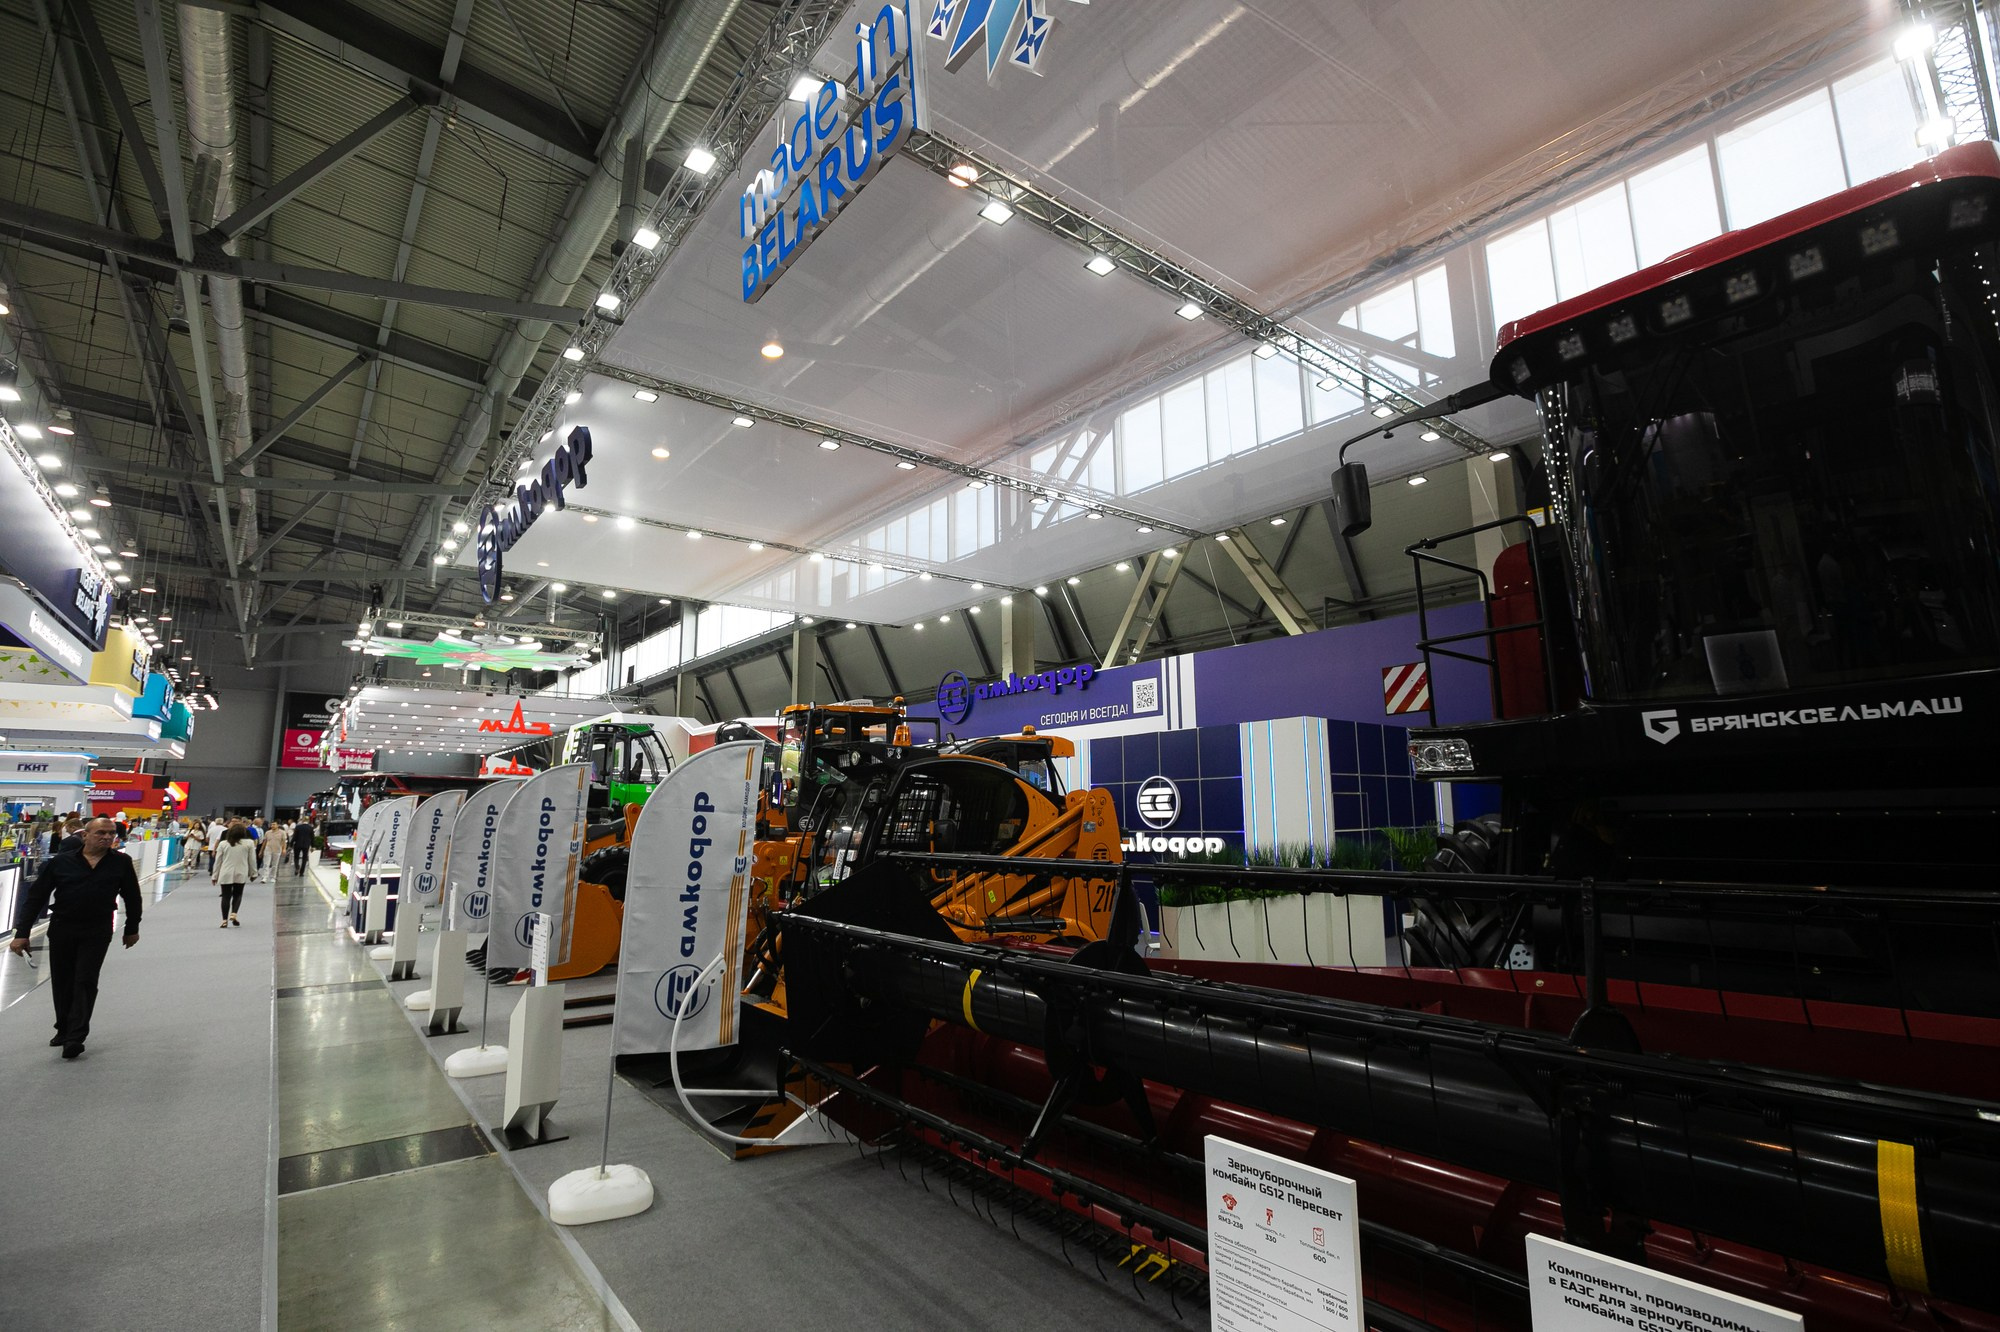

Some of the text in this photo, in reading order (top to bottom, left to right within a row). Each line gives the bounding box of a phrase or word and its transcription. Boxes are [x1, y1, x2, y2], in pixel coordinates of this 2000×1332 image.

[742, 73, 907, 303] BELARUS
[1040, 703, 1129, 726] СЕГОДНЯ И ВСЕГДА!
[1691, 696, 1963, 733] БРЯНСКСЕЛЬМАШ
[17, 763, 49, 772] ГКНТ
[1212, 1168, 1343, 1221] комбайн GS12 Пересвет
[1227, 1157, 1322, 1199] Зерноуборочный
[1265, 1233, 1277, 1244] 330
[1312, 1253, 1327, 1264] 600
[1548, 1260, 1642, 1300] Компоненты,
[1548, 1276, 1557, 1286] в
[1560, 1278, 1595, 1298] ЕАЭС
[1599, 1293, 1626, 1310] для
[1564, 1295, 1634, 1327] комбайна
